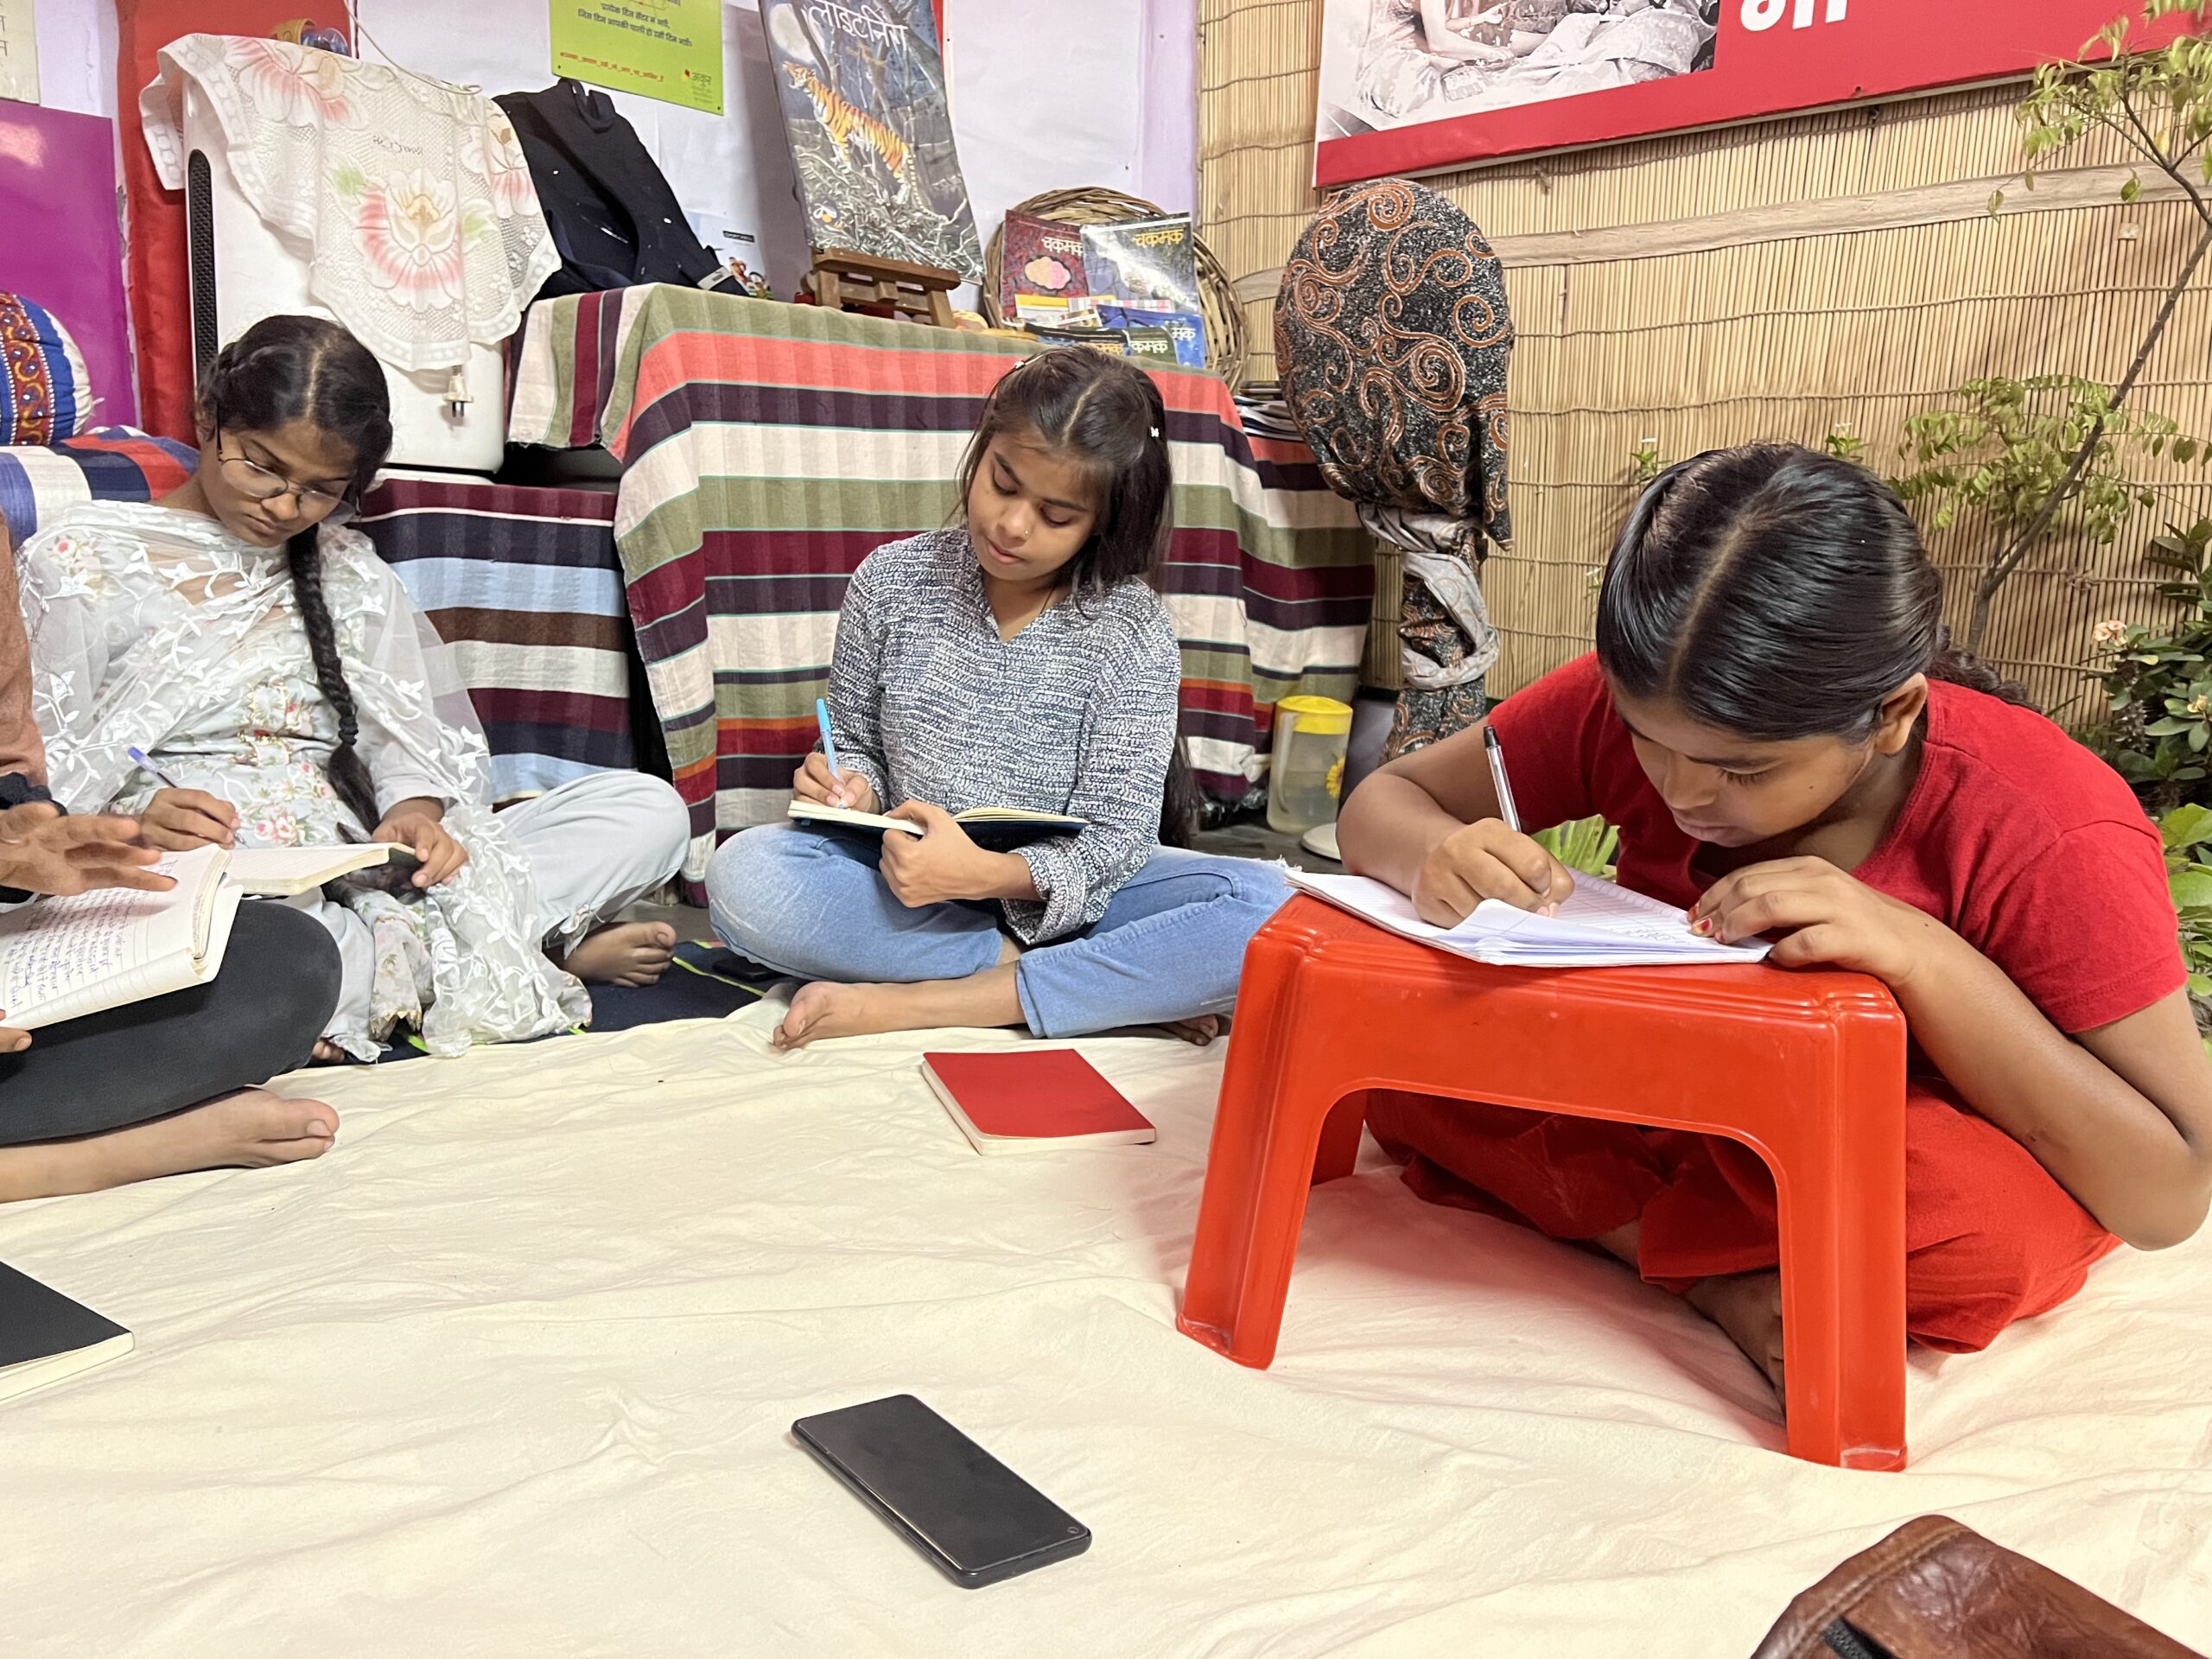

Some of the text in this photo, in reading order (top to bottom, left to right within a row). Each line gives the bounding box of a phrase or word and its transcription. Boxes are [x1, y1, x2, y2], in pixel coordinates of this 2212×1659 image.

[1041, 236, 1084, 256] चकमक
[1133, 228, 1185, 249] चकमक
[1171, 327, 1196, 340] मक
[1130, 340, 1168, 354] कमक
